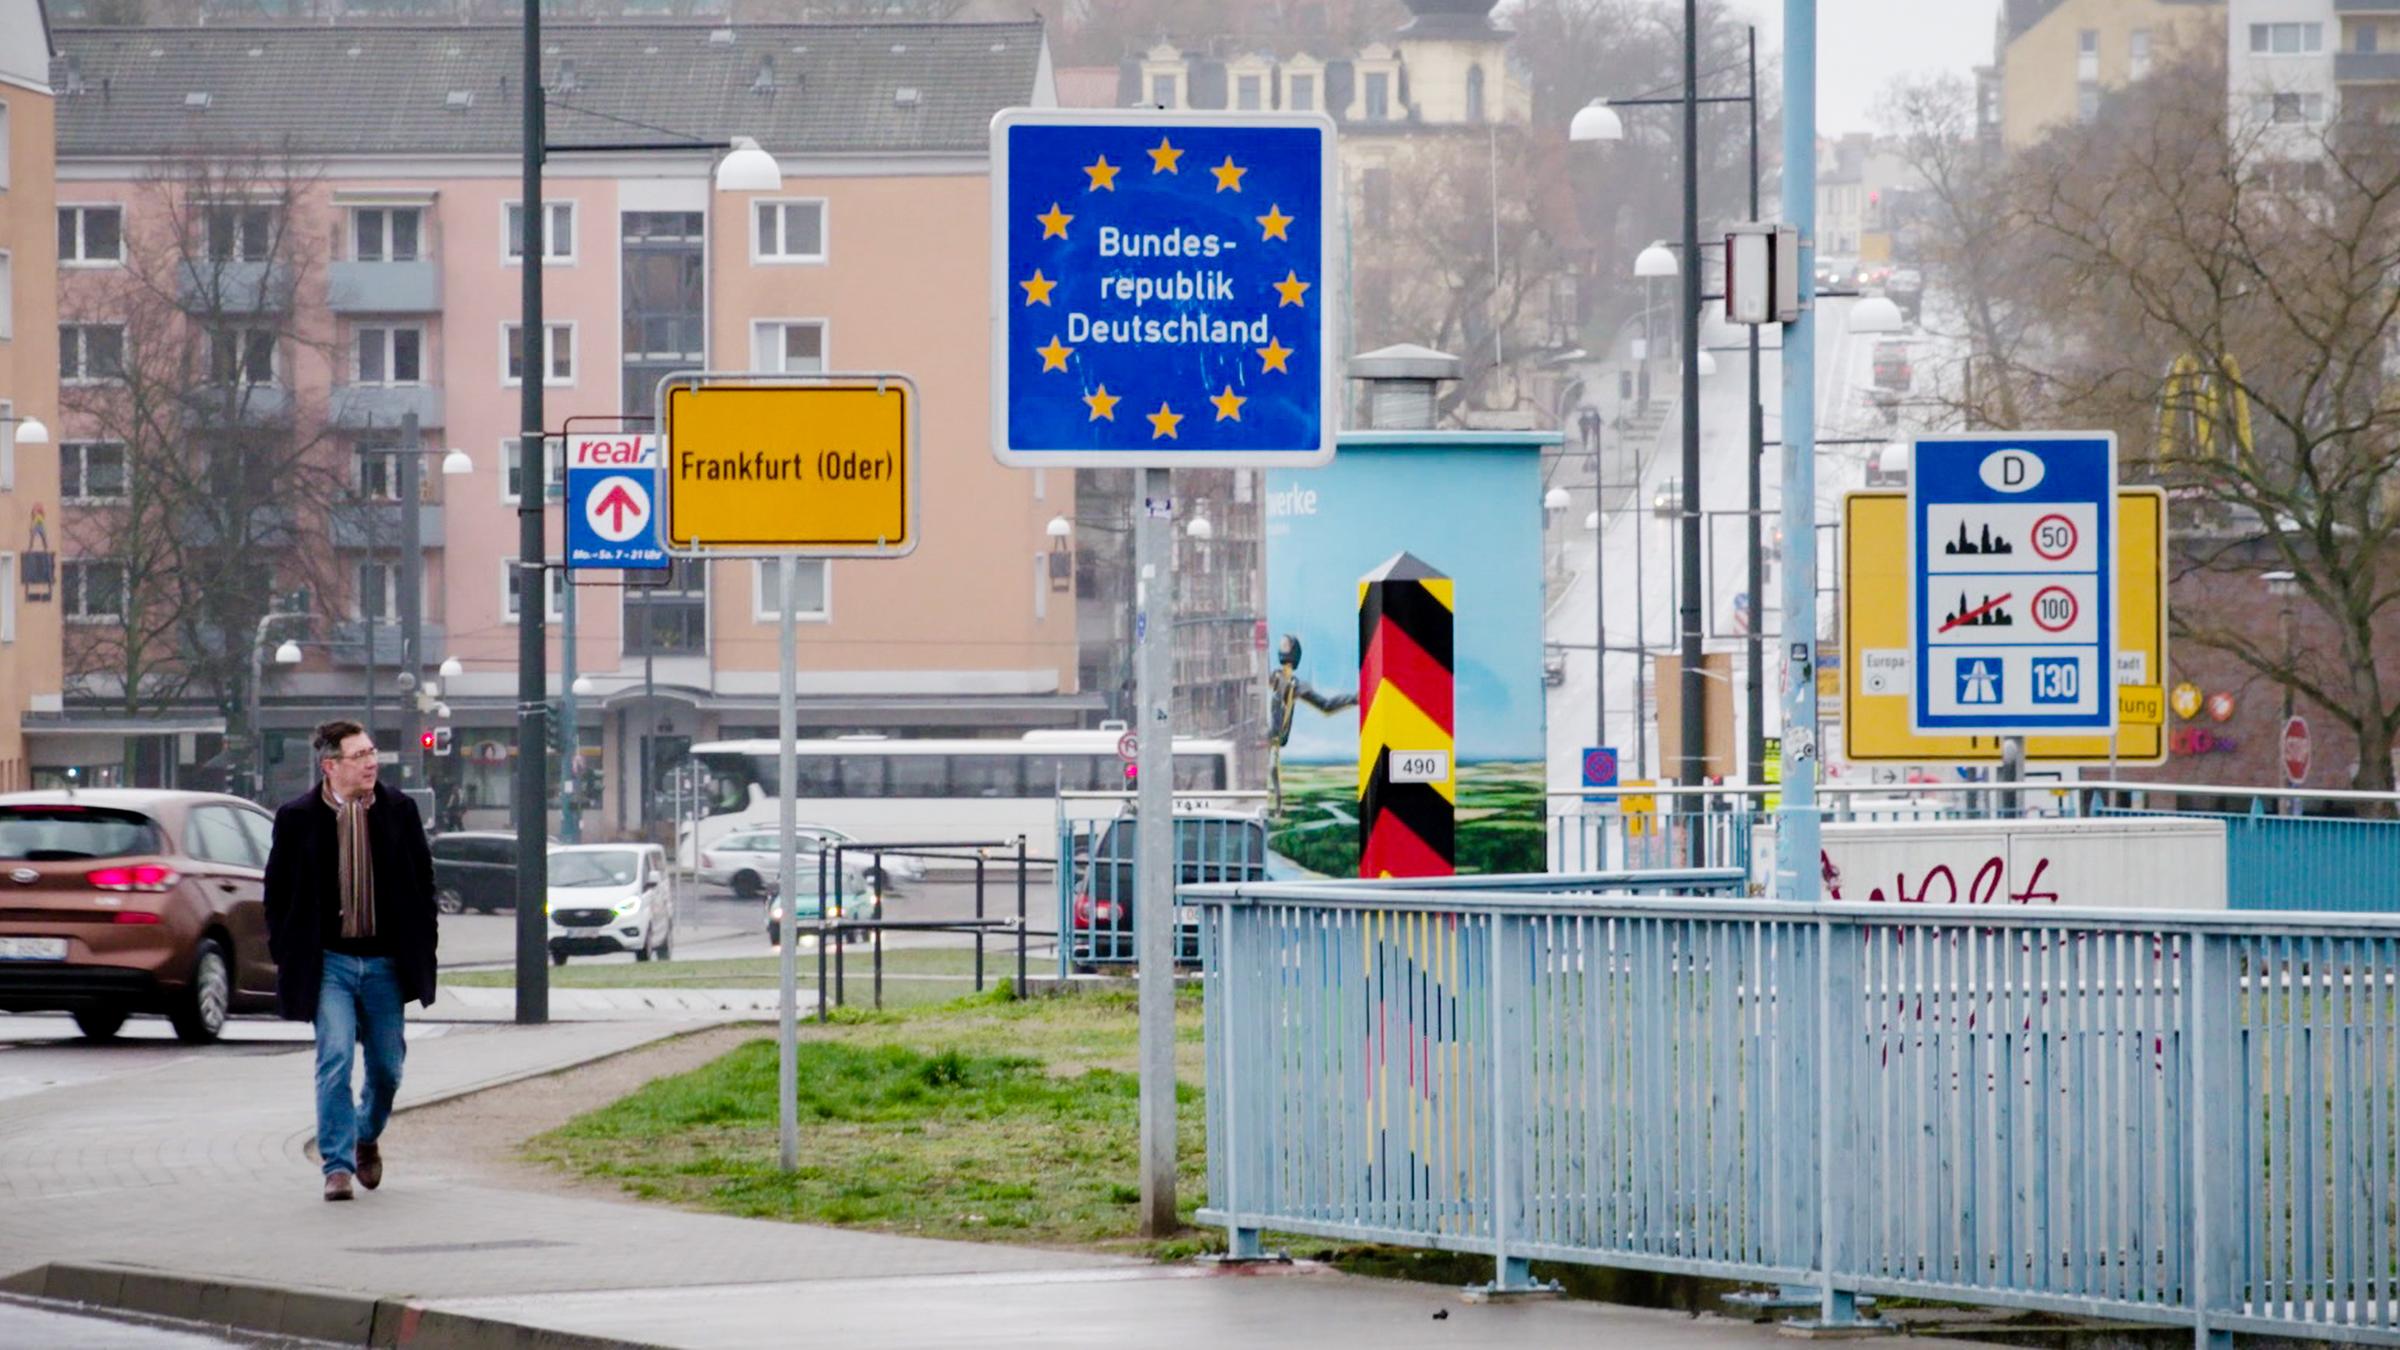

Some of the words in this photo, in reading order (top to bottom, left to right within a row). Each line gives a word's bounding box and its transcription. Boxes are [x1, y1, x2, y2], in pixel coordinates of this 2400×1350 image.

[1099, 227, 1237, 257] Bundes-
[1100, 270, 1234, 306] republik
[1068, 312, 1268, 343] Deutschland
[681, 451, 802, 481] Frankfurt
[817, 450, 893, 480] (Oder)
[2003, 456, 2025, 486] D
[2041, 526, 2069, 549] 50
[2041, 597, 2070, 622] 100
[2034, 664, 2077, 697] 130
[1403, 758, 1435, 775] 490
